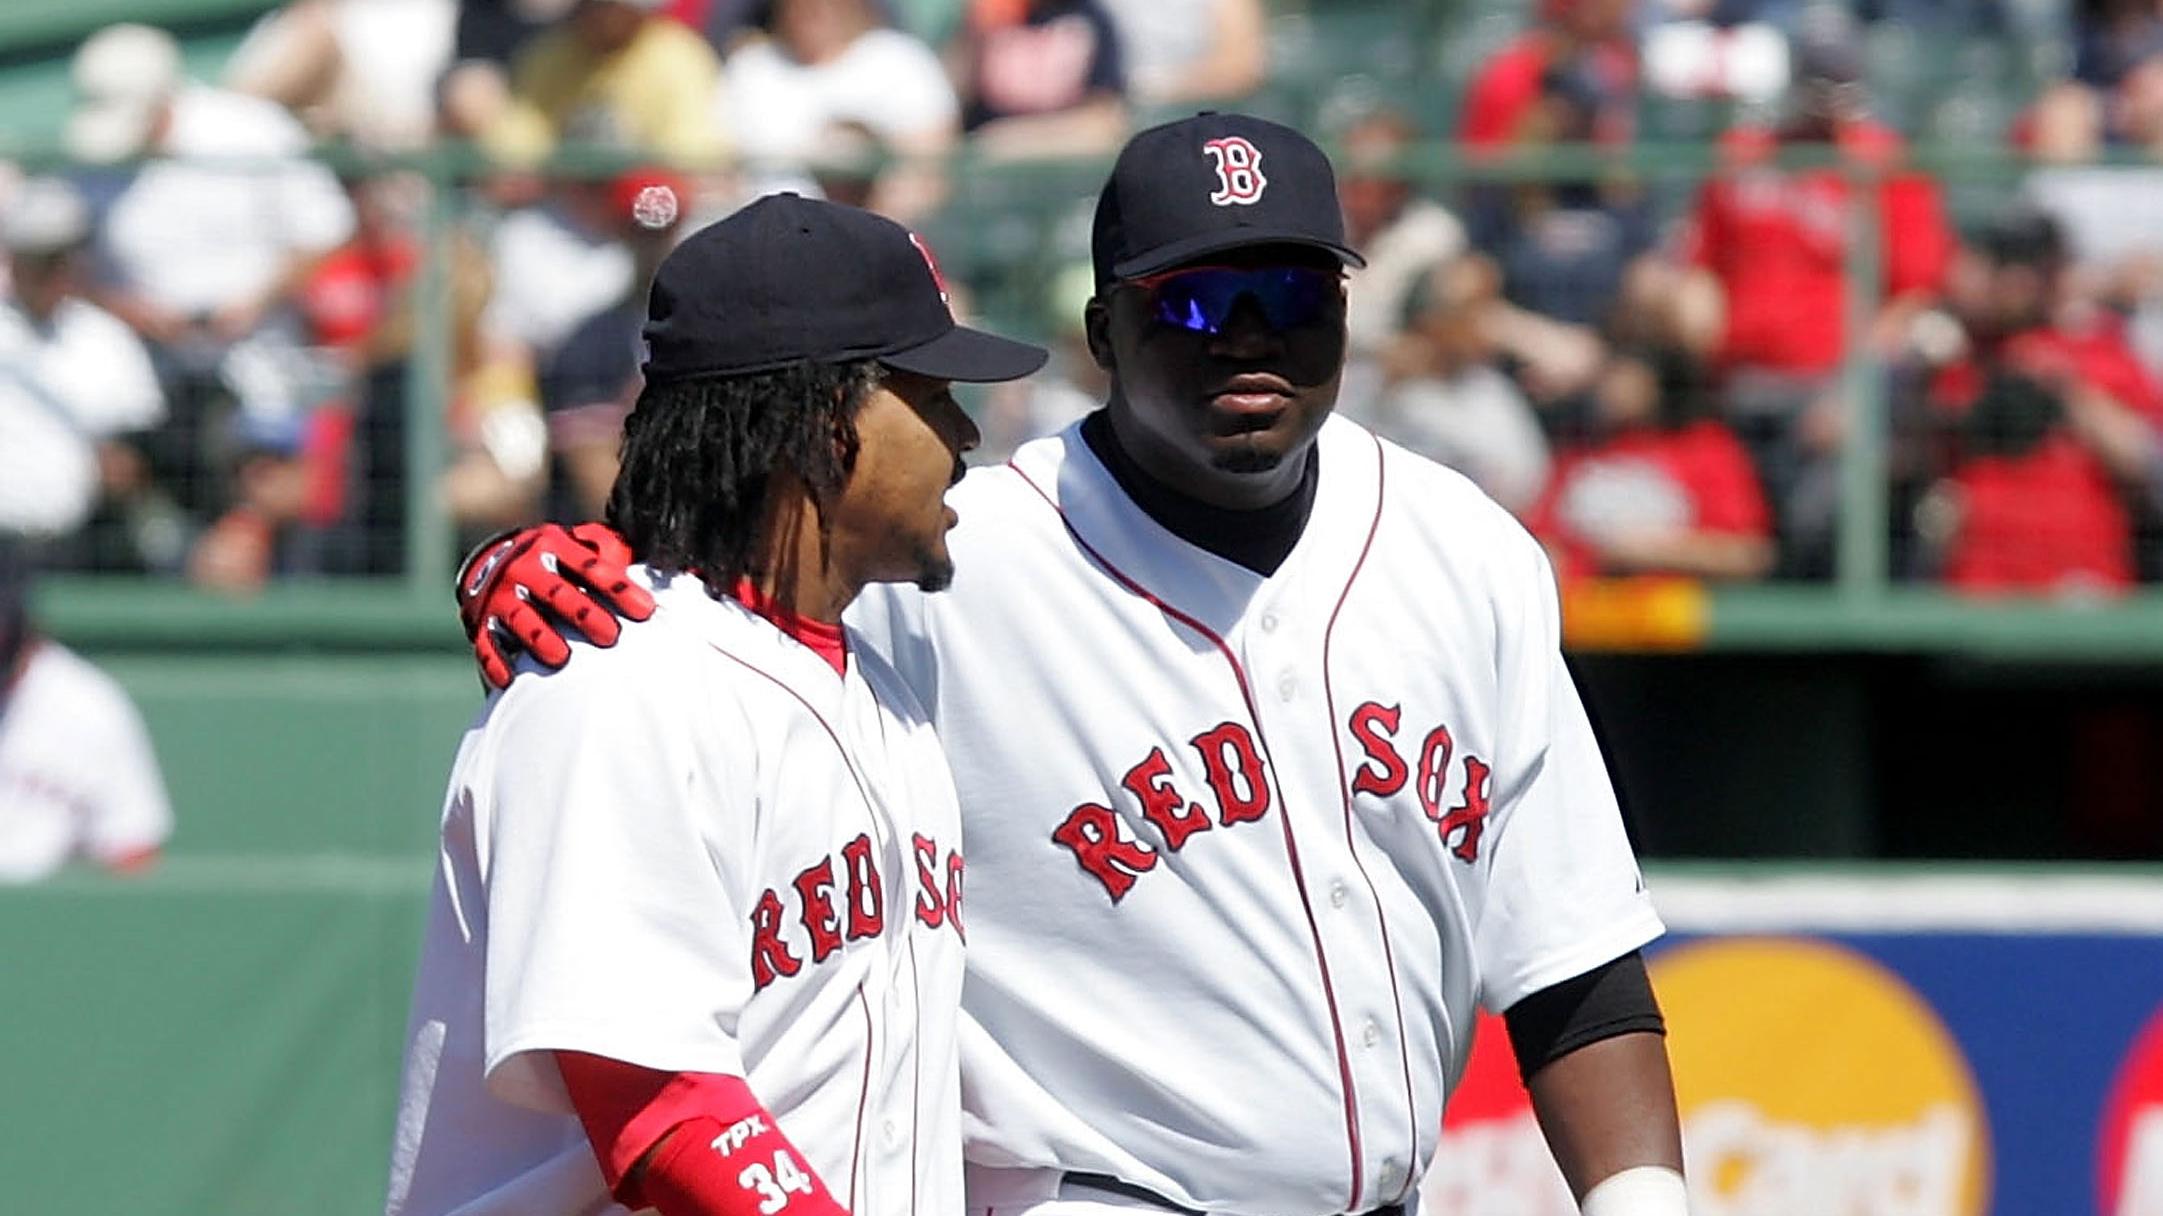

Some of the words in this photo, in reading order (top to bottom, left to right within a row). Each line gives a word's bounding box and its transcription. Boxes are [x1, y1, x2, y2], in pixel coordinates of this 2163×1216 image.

[1203, 136, 1267, 206] B
[1051, 721, 1270, 906] RED
[750, 832, 883, 994] RED
[710, 1113, 768, 1158] TPX
[738, 1149, 814, 1216] 34
